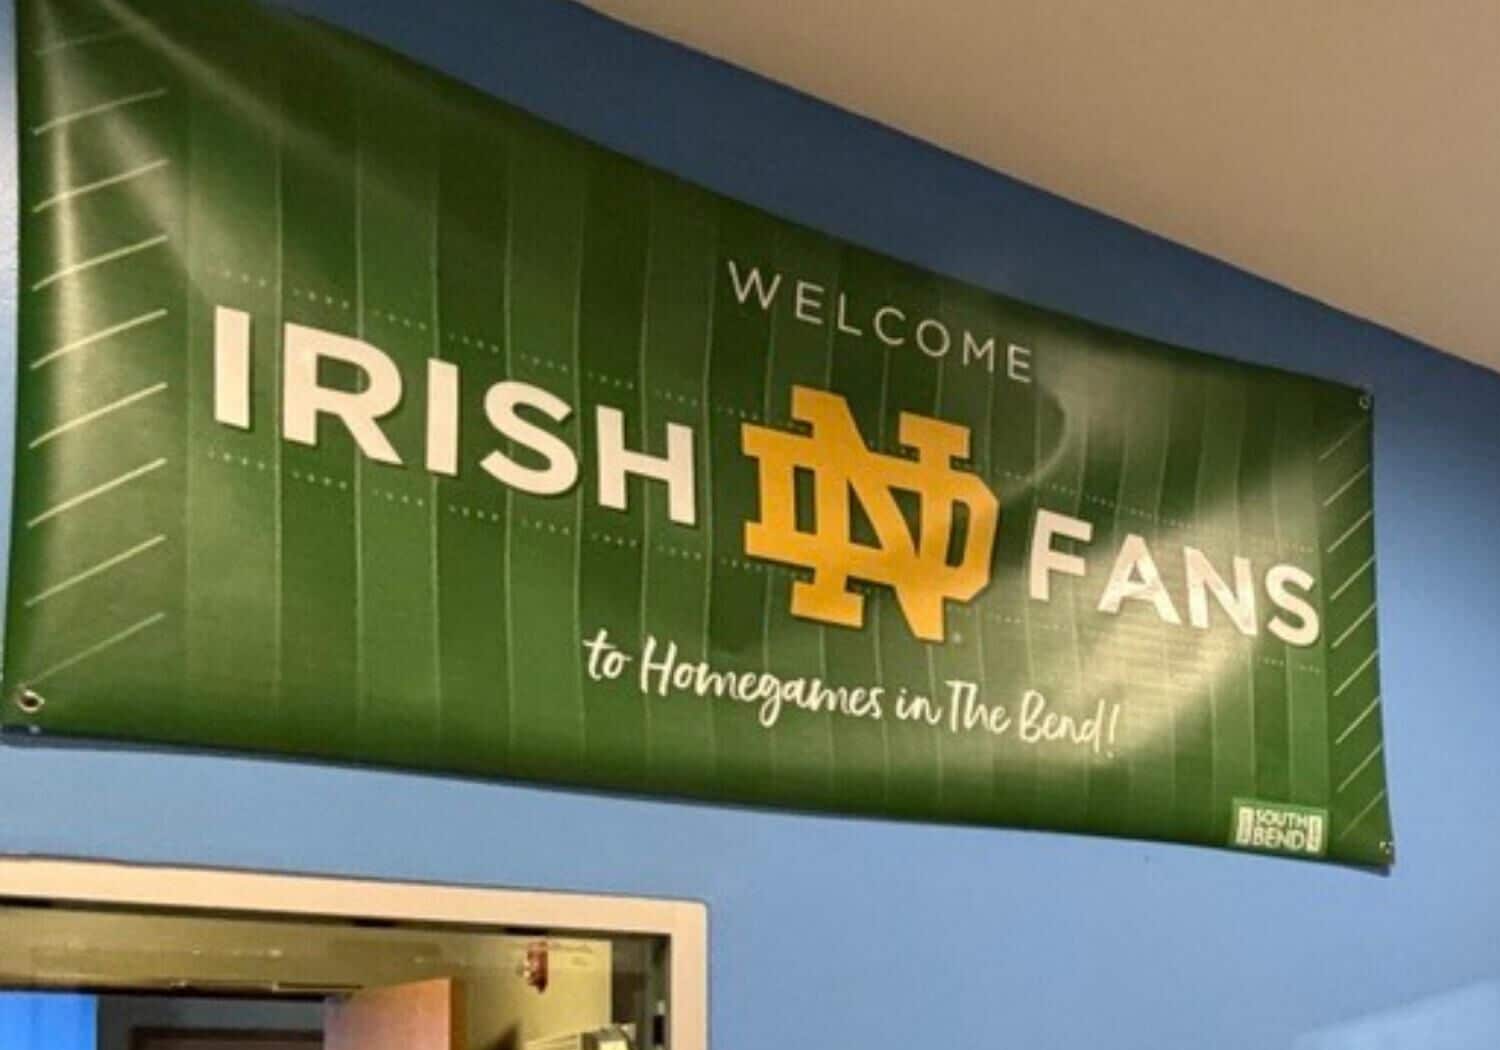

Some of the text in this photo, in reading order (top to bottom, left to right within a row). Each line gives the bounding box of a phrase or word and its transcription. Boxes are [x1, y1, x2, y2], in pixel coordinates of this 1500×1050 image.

[727, 260, 1034, 384] WELCOME
[213, 304, 697, 526] IRISH
[1028, 508, 1321, 649] FANS
[583, 628, 1120, 760] to Homegames in The Bend!
[1252, 827, 1305, 851] BEND
[1255, 809, 1309, 829] SOUTH
